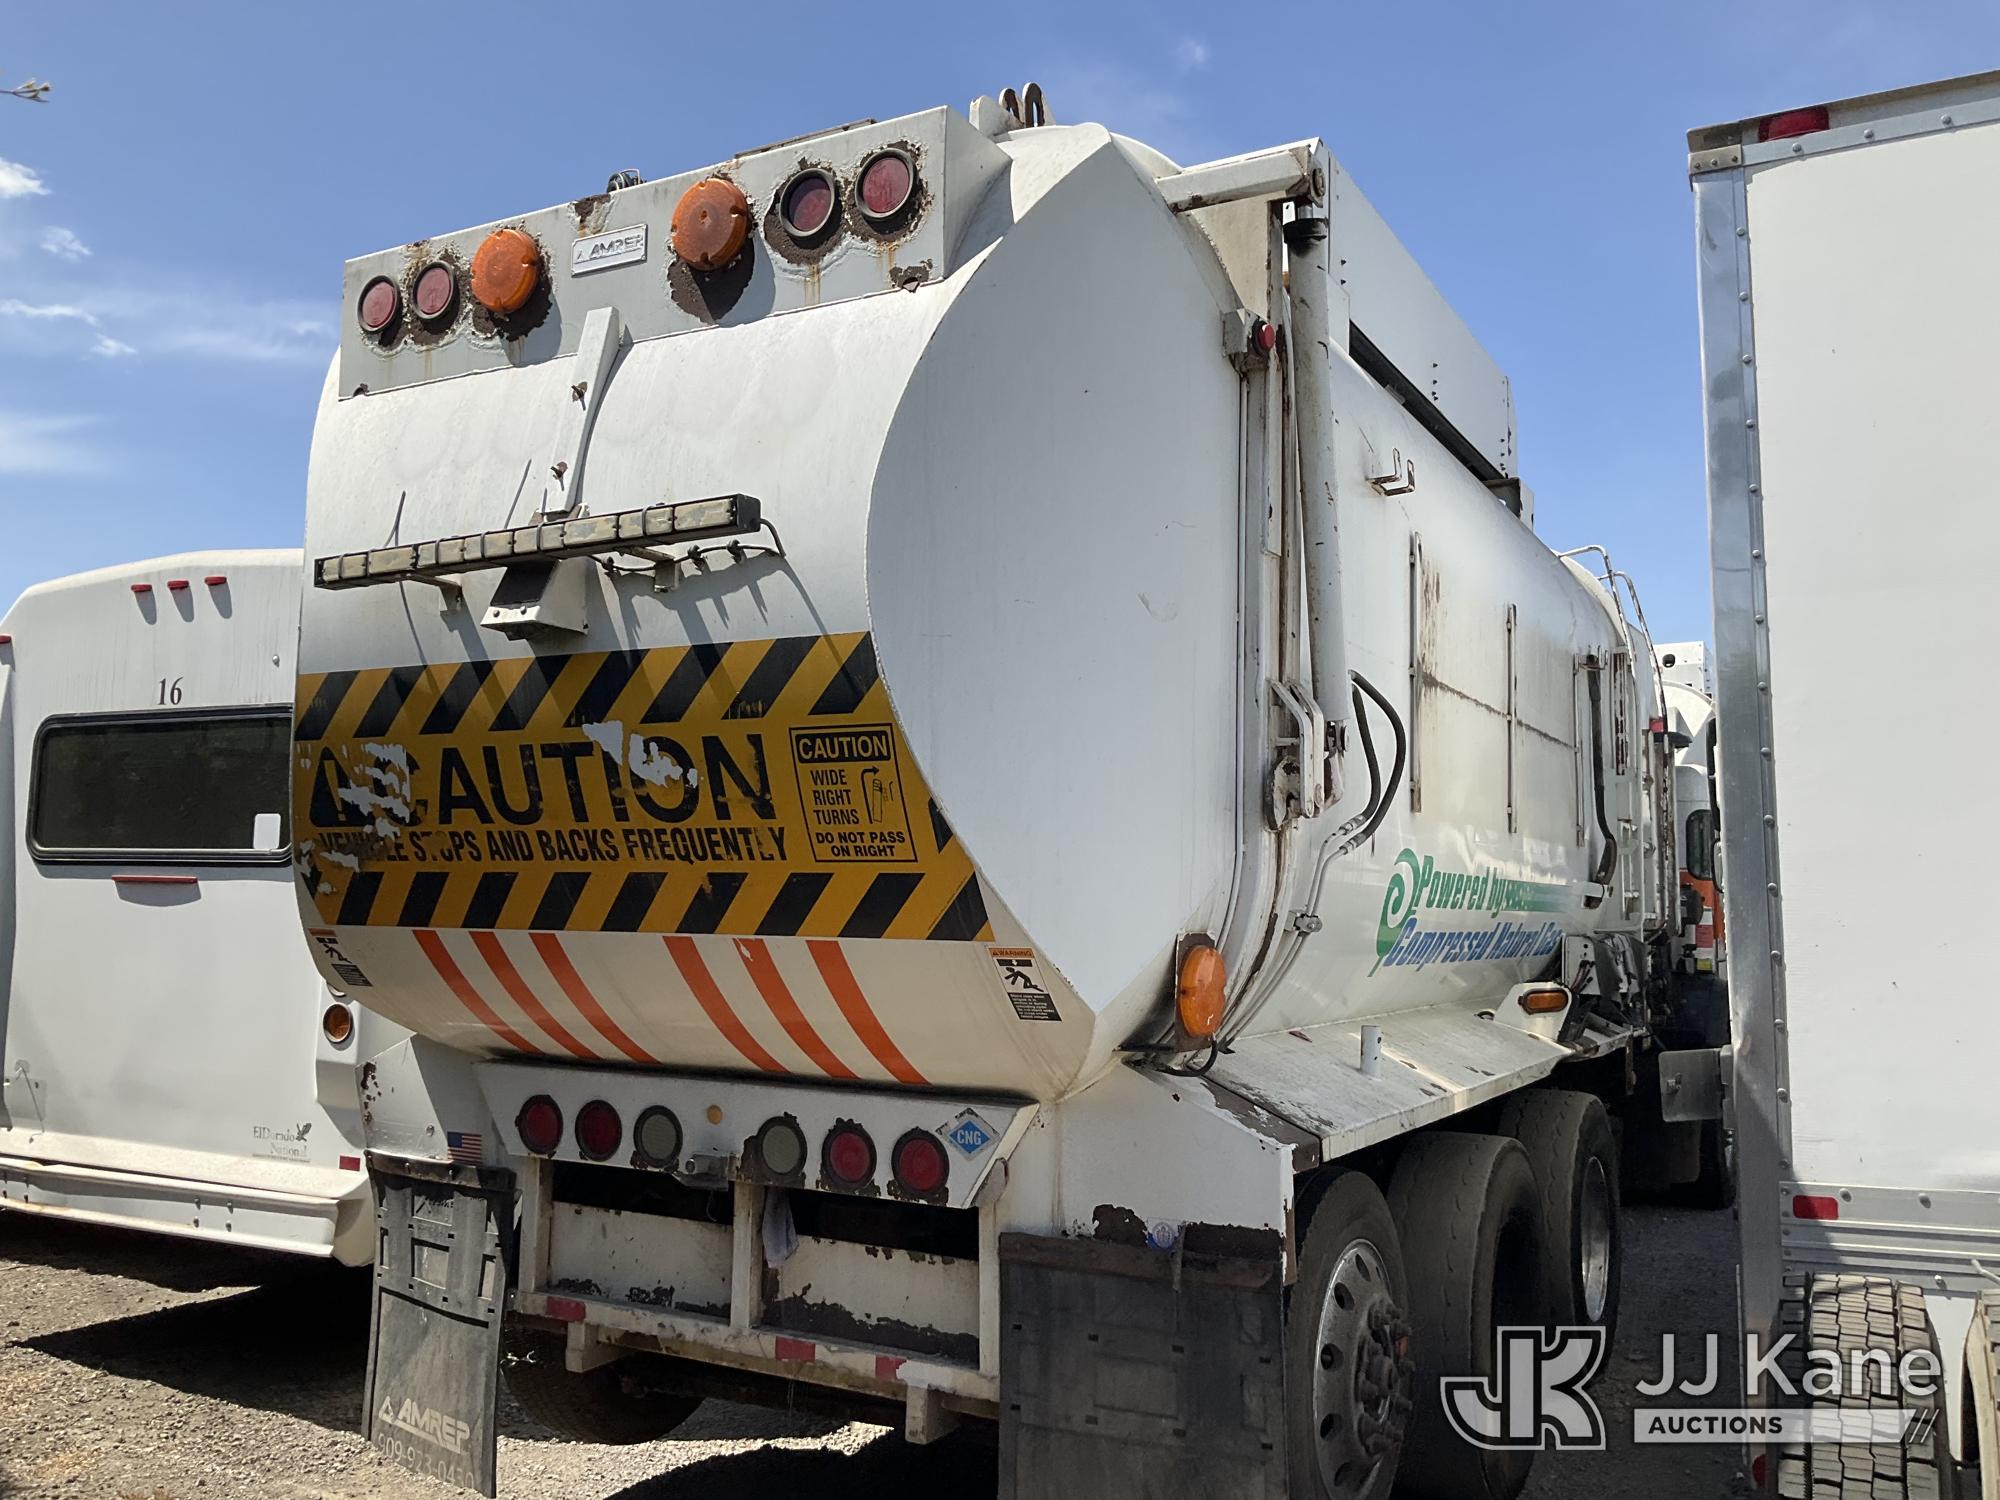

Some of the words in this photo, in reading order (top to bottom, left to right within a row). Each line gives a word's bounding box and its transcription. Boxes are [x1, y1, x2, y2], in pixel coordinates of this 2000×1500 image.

[157, 676, 184, 706] 16
[799, 735, 888, 760] CAUTION
[373, 733, 777, 827] CAUTION
[810, 769, 848, 786] WIDE
[812, 789, 852, 806] RIGHT
[813, 808, 860, 825] TURNS
[319, 831, 409, 862] VEHIE
[486, 830, 534, 862] AND
[536, 828, 620, 862] BACKS
[622, 827, 788, 865] FREQUENTLY
[815, 832, 835, 844] DO
[838, 831, 866, 844] NOT
[868, 831, 906, 844] PASS
[831, 845, 851, 857] ON
[854, 845, 896, 857] RIGHT
[1413, 855, 1492, 911] Powered
[1490, 867, 1506, 919] by
[1382, 917, 1501, 972] Compressed
[1485, 921, 1547, 961] Natural
[1531, 921, 1563, 956] Gas
[957, 1129, 982, 1146] CNG
[398, 1398, 471, 1446] AMREP
